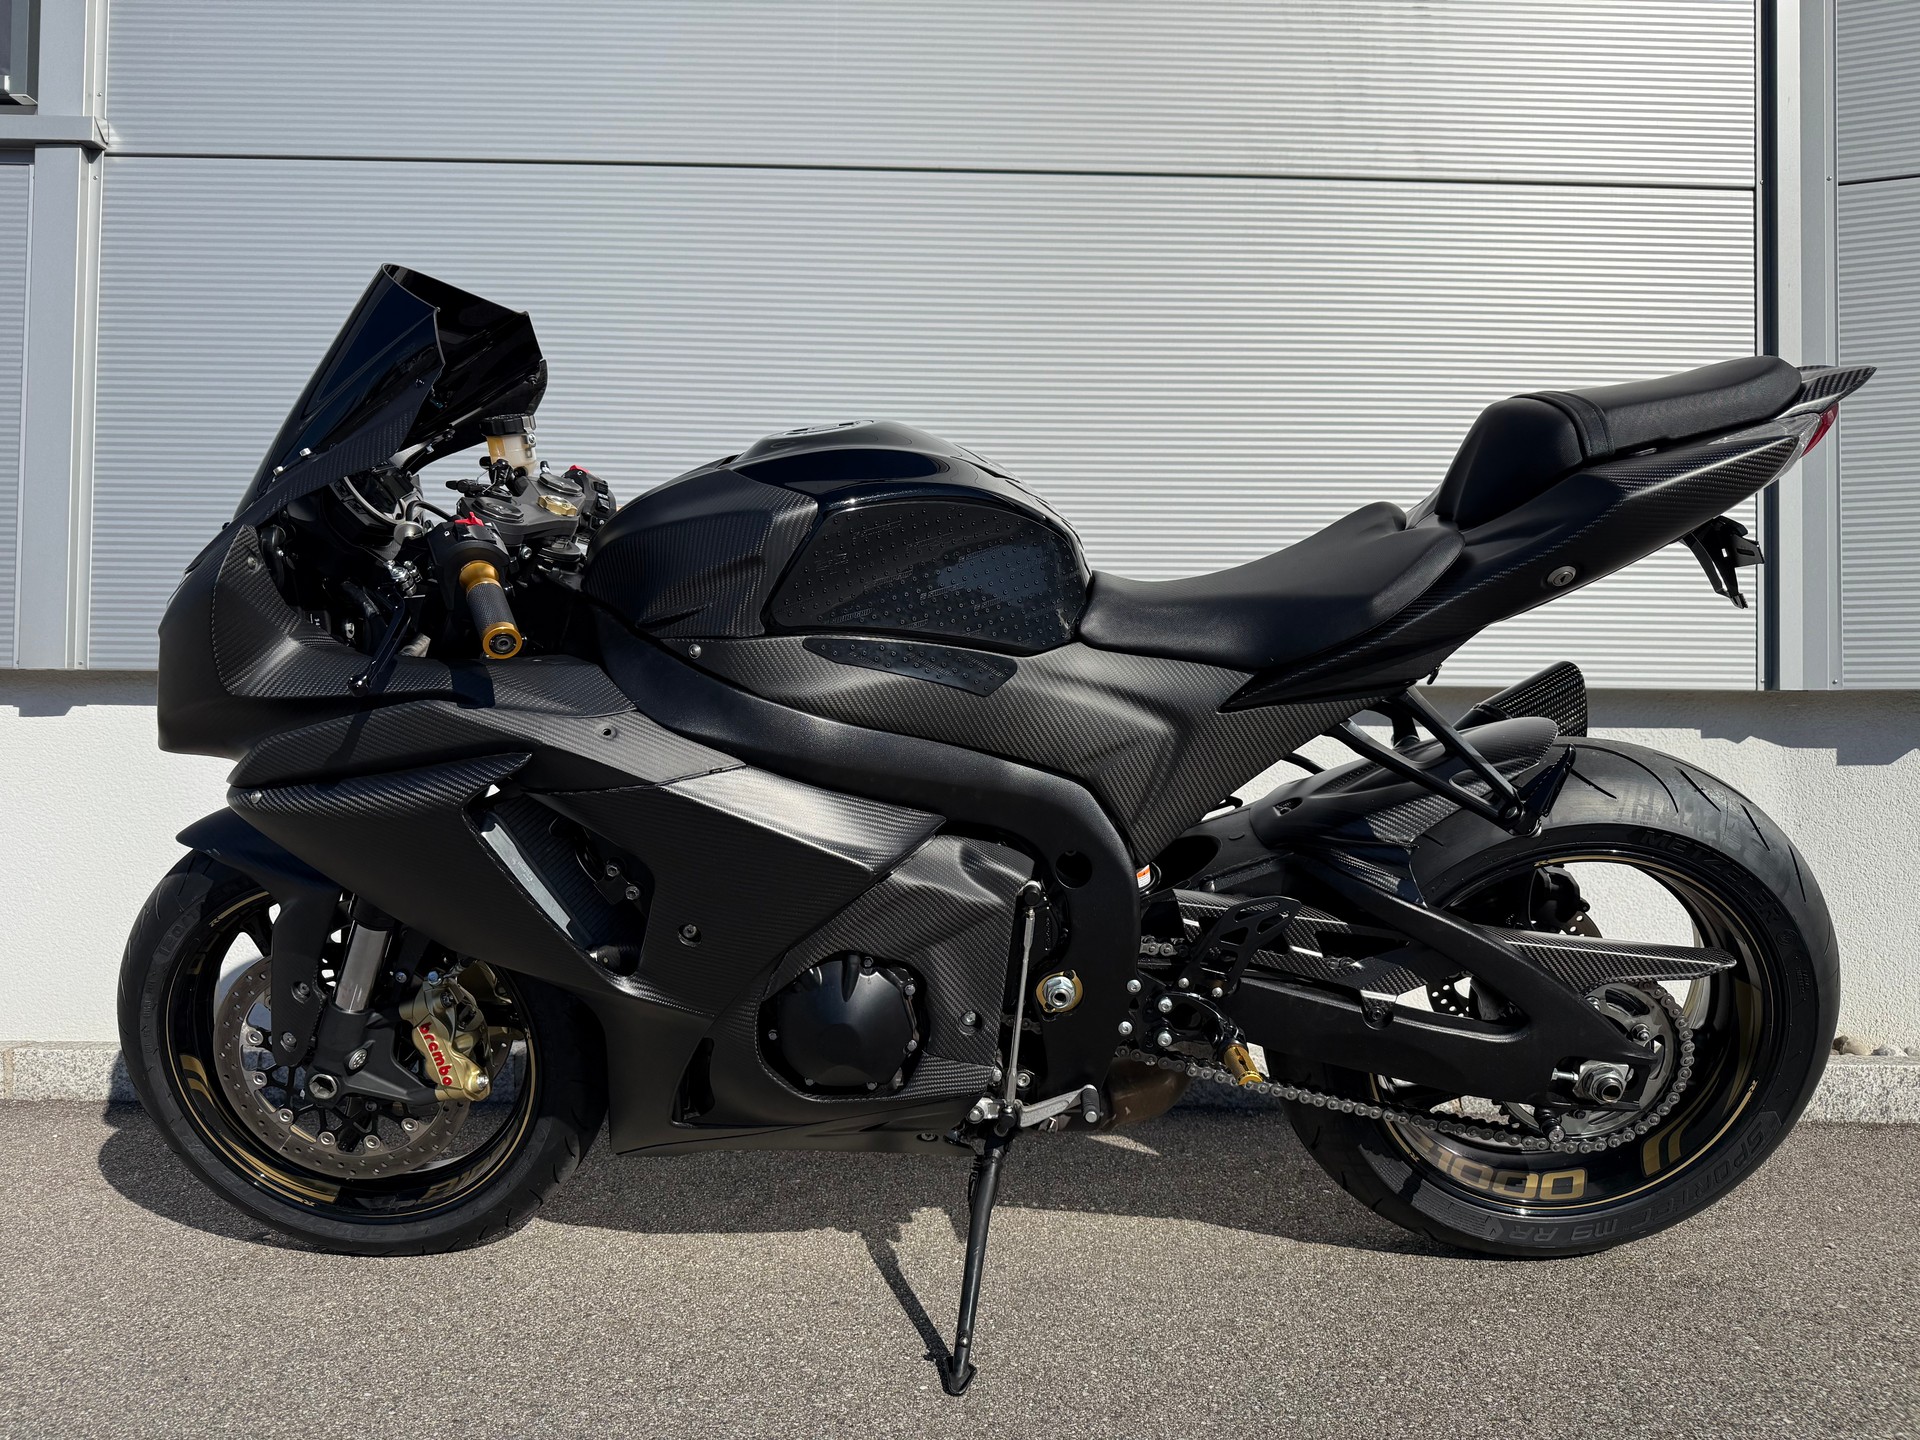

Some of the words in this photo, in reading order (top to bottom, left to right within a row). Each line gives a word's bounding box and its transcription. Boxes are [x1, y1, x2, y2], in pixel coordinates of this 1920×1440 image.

[1640, 829, 1788, 923] METZELER
[419, 1022, 453, 1086] brembo
[1436, 1147, 1586, 1200] 1000
[1630, 1119, 1764, 1231] SPORTEC
[1508, 1225, 1560, 1242] RR
